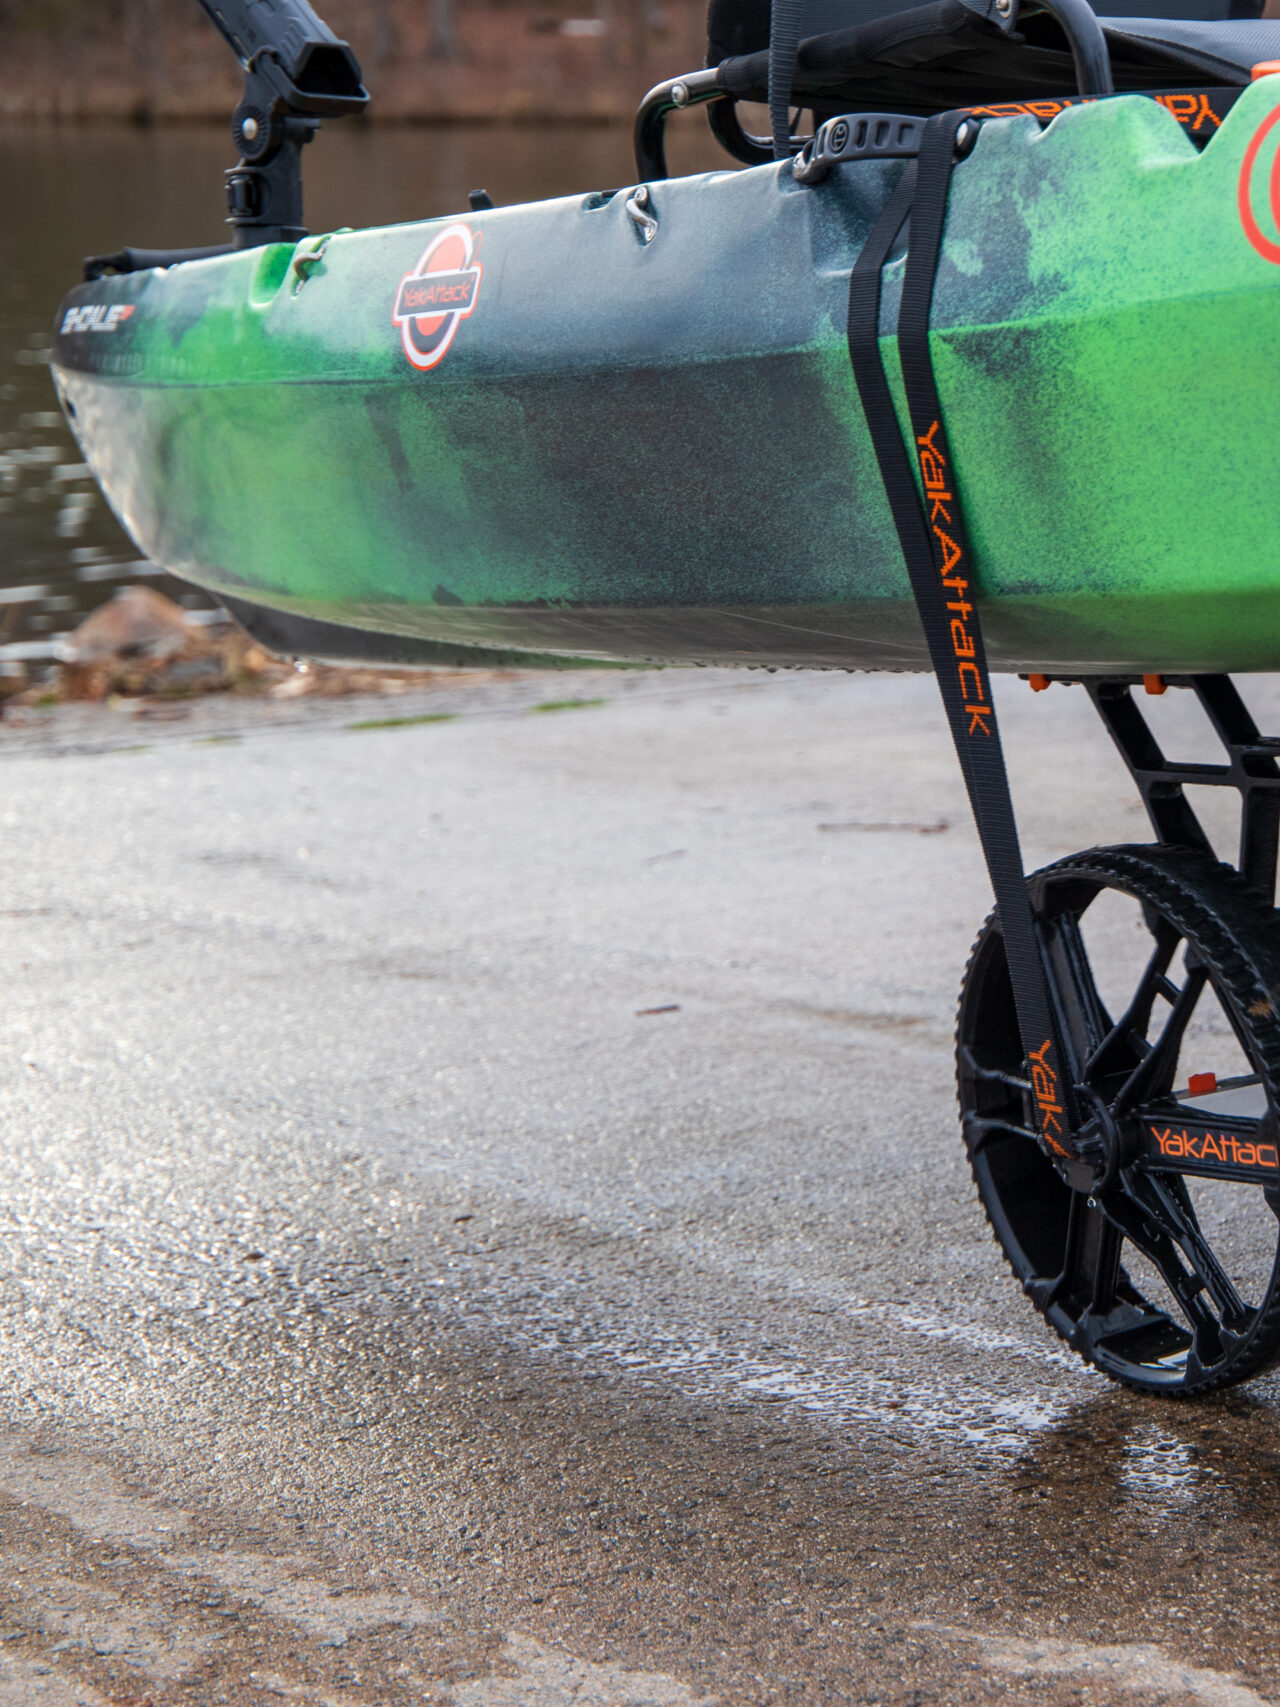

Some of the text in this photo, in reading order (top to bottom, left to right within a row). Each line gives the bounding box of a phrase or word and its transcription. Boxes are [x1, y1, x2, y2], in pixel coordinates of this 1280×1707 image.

[404, 281, 471, 307] YakAttack
[917, 420, 991, 736] YakAttack
[1150, 1126, 1279, 1168] YakAttac
